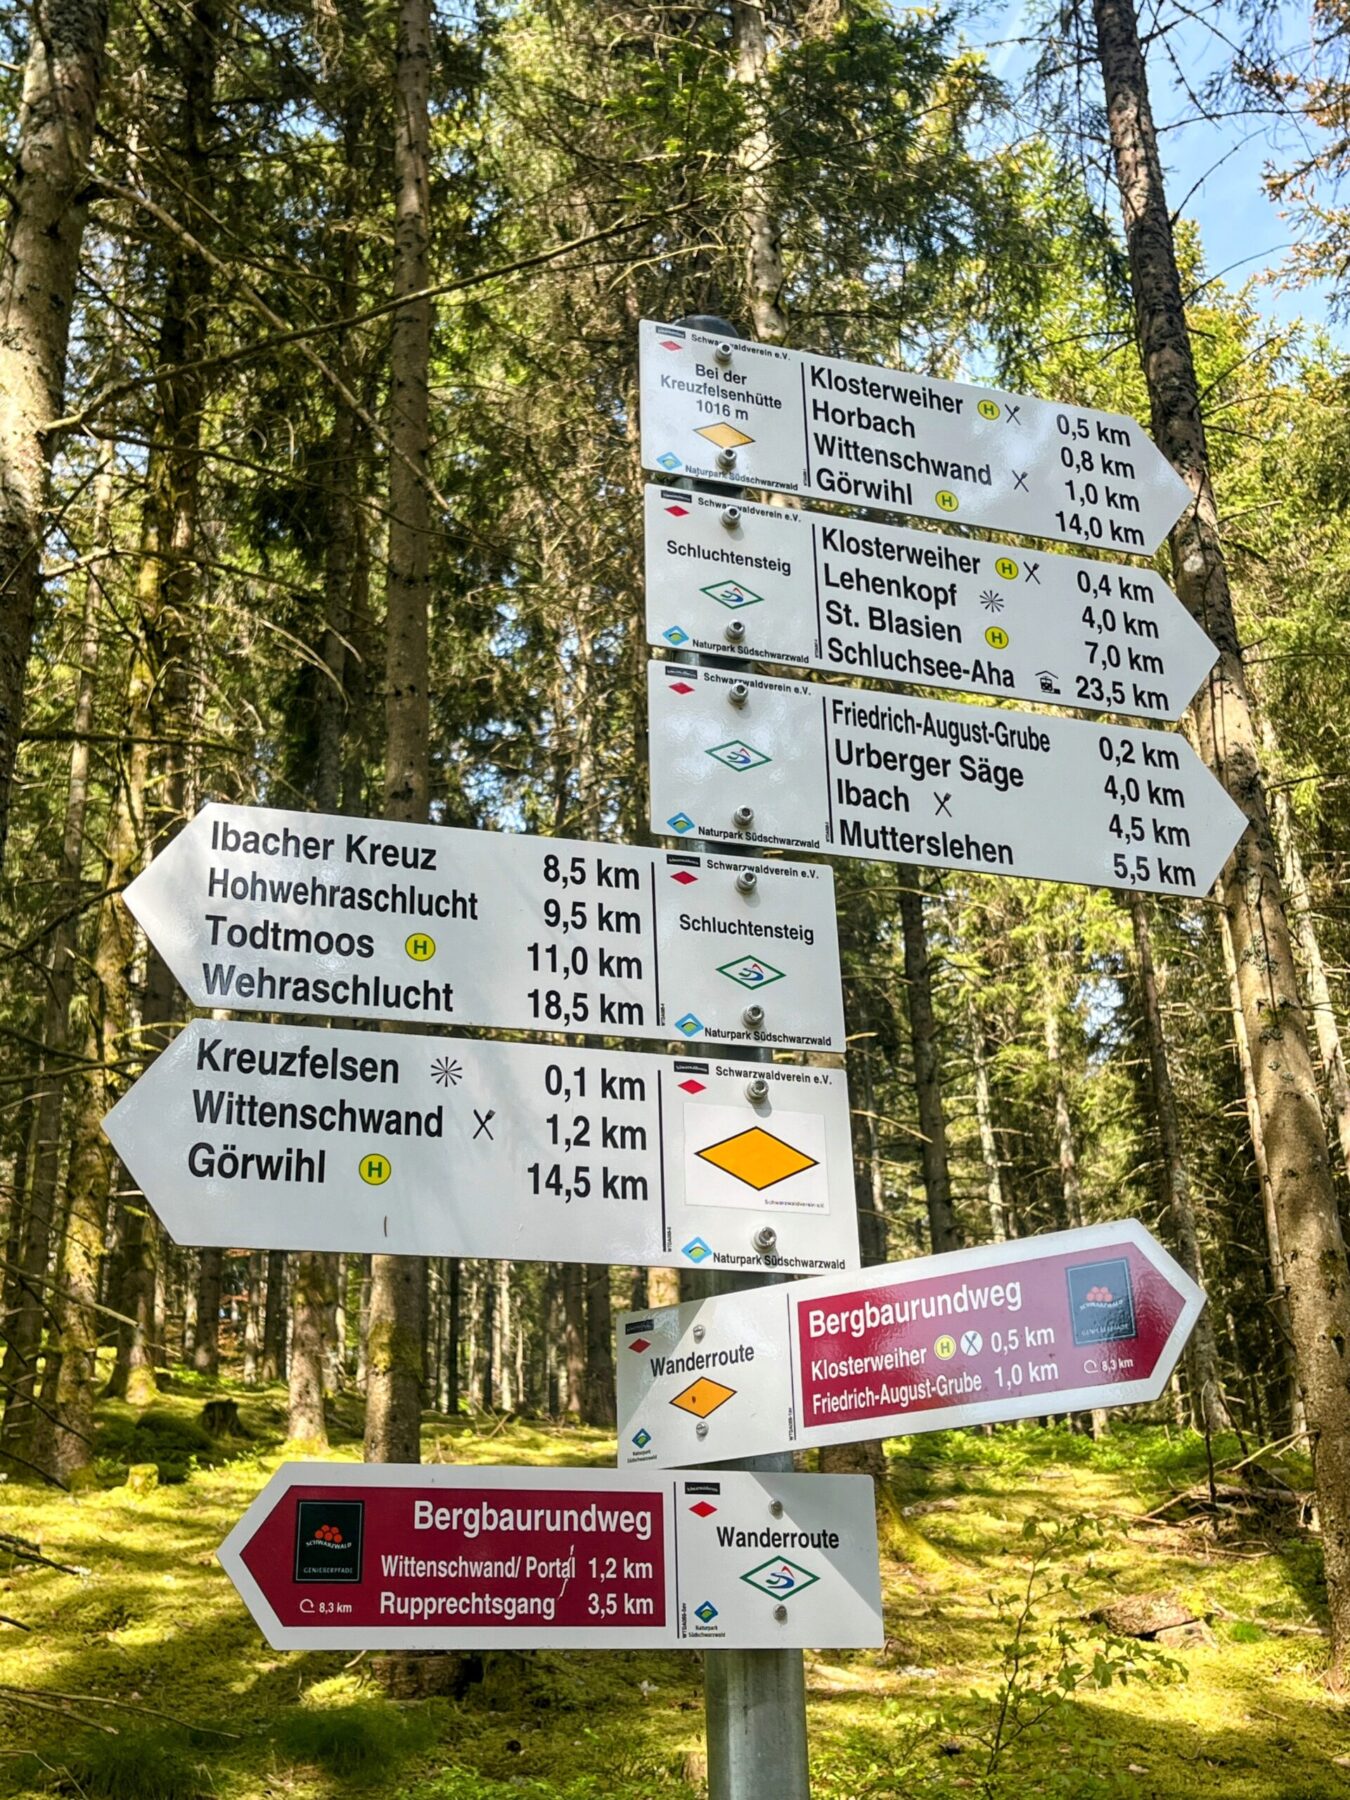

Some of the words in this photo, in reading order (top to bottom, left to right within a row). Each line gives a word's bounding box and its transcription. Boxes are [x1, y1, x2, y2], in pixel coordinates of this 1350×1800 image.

[692, 334, 772, 357] Schwaaldverein
[775, 352, 790, 360] e.V.
[661, 374, 782, 409] Kreuzfelsenhütte
[695, 364, 718, 379] Bei
[724, 371, 747, 384] der
[697, 399, 730, 416] 1016
[736, 410, 748, 420] m
[811, 366, 964, 414] Klosterweiher
[1057, 414, 1089, 440] 0,5
[1097, 421, 1130, 447] km
[812, 399, 915, 438] Horbach
[1061, 447, 1094, 473] 0,8
[1101, 454, 1135, 479] km
[685, 465, 727, 478] Naturpark
[729, 472, 798, 491] Südschwarzwald
[814, 433, 992, 485] Wittenschwand
[1065, 480, 1098, 507] 1,0
[1106, 486, 1140, 512] km
[784, 513, 801, 522] e.V.
[817, 468, 913, 505] Görwihl
[1055, 511, 1102, 540] 14,0
[1110, 520, 1145, 546] km
[667, 540, 791, 576] Schluchtensteig
[822, 527, 981, 574] Klosterweiher
[1077, 570, 1111, 598] 0,4
[1119, 577, 1154, 603] km
[824, 563, 957, 610] Lehenkopf
[1082, 606, 1116, 634] 4,0
[1123, 612, 1159, 639] km
[693, 639, 735, 653] Naturpark
[737, 645, 809, 664] Südschwarzwald
[826, 600, 859, 627] St.
[869, 606, 962, 643] Blasien
[1085, 641, 1120, 671] 7,0
[1128, 647, 1164, 675] km
[794, 686, 811, 695] e.V.
[828, 637, 1015, 688] Schluchsee-Aha
[1076, 675, 1125, 707] 23,5
[1133, 684, 1169, 711] km
[833, 699, 1050, 752] Friedrich-August-Grube
[1099, 737, 1135, 767] 0,2
[1142, 742, 1180, 770] km
[835, 739, 950, 781] Urberger
[960, 755, 1024, 792] Säge
[1104, 775, 1139, 805] 4,0
[1147, 780, 1185, 808] km
[837, 779, 909, 812] Ibach
[1109, 814, 1145, 844] 4,5
[1152, 818, 1190, 847] km
[212, 821, 334, 860] Ibacher
[346, 834, 437, 871] Kreuz
[544, 854, 586, 889] 8,5
[597, 859, 639, 890] km
[698, 826, 743, 840] Naturpark
[745, 832, 820, 849] Südschwarzwald
[840, 819, 1014, 865] Mutterslehen
[1114, 853, 1150, 885] 5,5
[1158, 858, 1196, 887] km
[801, 870, 819, 879] e.V.
[208, 867, 478, 920] Hohwehraschlucht
[544, 899, 587, 934] 9,5
[598, 903, 641, 934] km
[205, 914, 374, 958] Todtmoos
[528, 942, 588, 980] 11,0
[599, 947, 642, 979] km
[680, 914, 814, 945] Schluchtensteig
[202, 963, 453, 1012] Wehraschlucht
[528, 989, 588, 1026] 18,5
[600, 993, 643, 1026] km
[705, 1028, 751, 1040] Naturpark
[754, 1032, 832, 1046] Südschwarzwald
[197, 1038, 398, 1084] Kreuzfelsen
[545, 1065, 585, 1102] 0,1
[601, 1068, 645, 1101] km
[716, 1066, 811, 1084] Schwarzwaldverein
[814, 1076, 832, 1085] e.V.
[193, 1089, 443, 1137] Wittenschwand
[546, 1114, 590, 1152] 1,2
[602, 1117, 646, 1150] km
[188, 1142, 325, 1183] Görwihl
[527, 1163, 591, 1203] 14,5
[603, 1167, 648, 1200] km
[713, 1253, 762, 1265] Naturpark
[765, 1256, 845, 1269] Südschwarzwald
[809, 1282, 1021, 1338] Bergbaurundweg
[651, 1344, 754, 1377] Wanderroute
[811, 1347, 926, 1381] Klosterweiher
[991, 1329, 1018, 1355] 0,5
[1025, 1327, 1055, 1347] km
[1102, 1359, 1117, 1371] 8,3
[1119, 1358, 1133, 1368] km
[813, 1372, 982, 1414] Friedrich-August-Grube
[995, 1366, 1022, 1390] 1,0
[1028, 1362, 1058, 1383] km
[414, 1501, 651, 1540] Bergbaurundweg
[717, 1527, 839, 1549] Wanderroute
[381, 1555, 521, 1578] Wittenschwand/
[526, 1557, 575, 1578] Portal
[588, 1558, 617, 1582] 1,2
[624, 1558, 652, 1578] km
[319, 1602, 334, 1613] 8,3
[337, 1603, 352, 1612] km
[380, 1592, 555, 1620] Rupprechtsgang
[588, 1594, 617, 1618] 3,5
[624, 1594, 654, 1614] km
